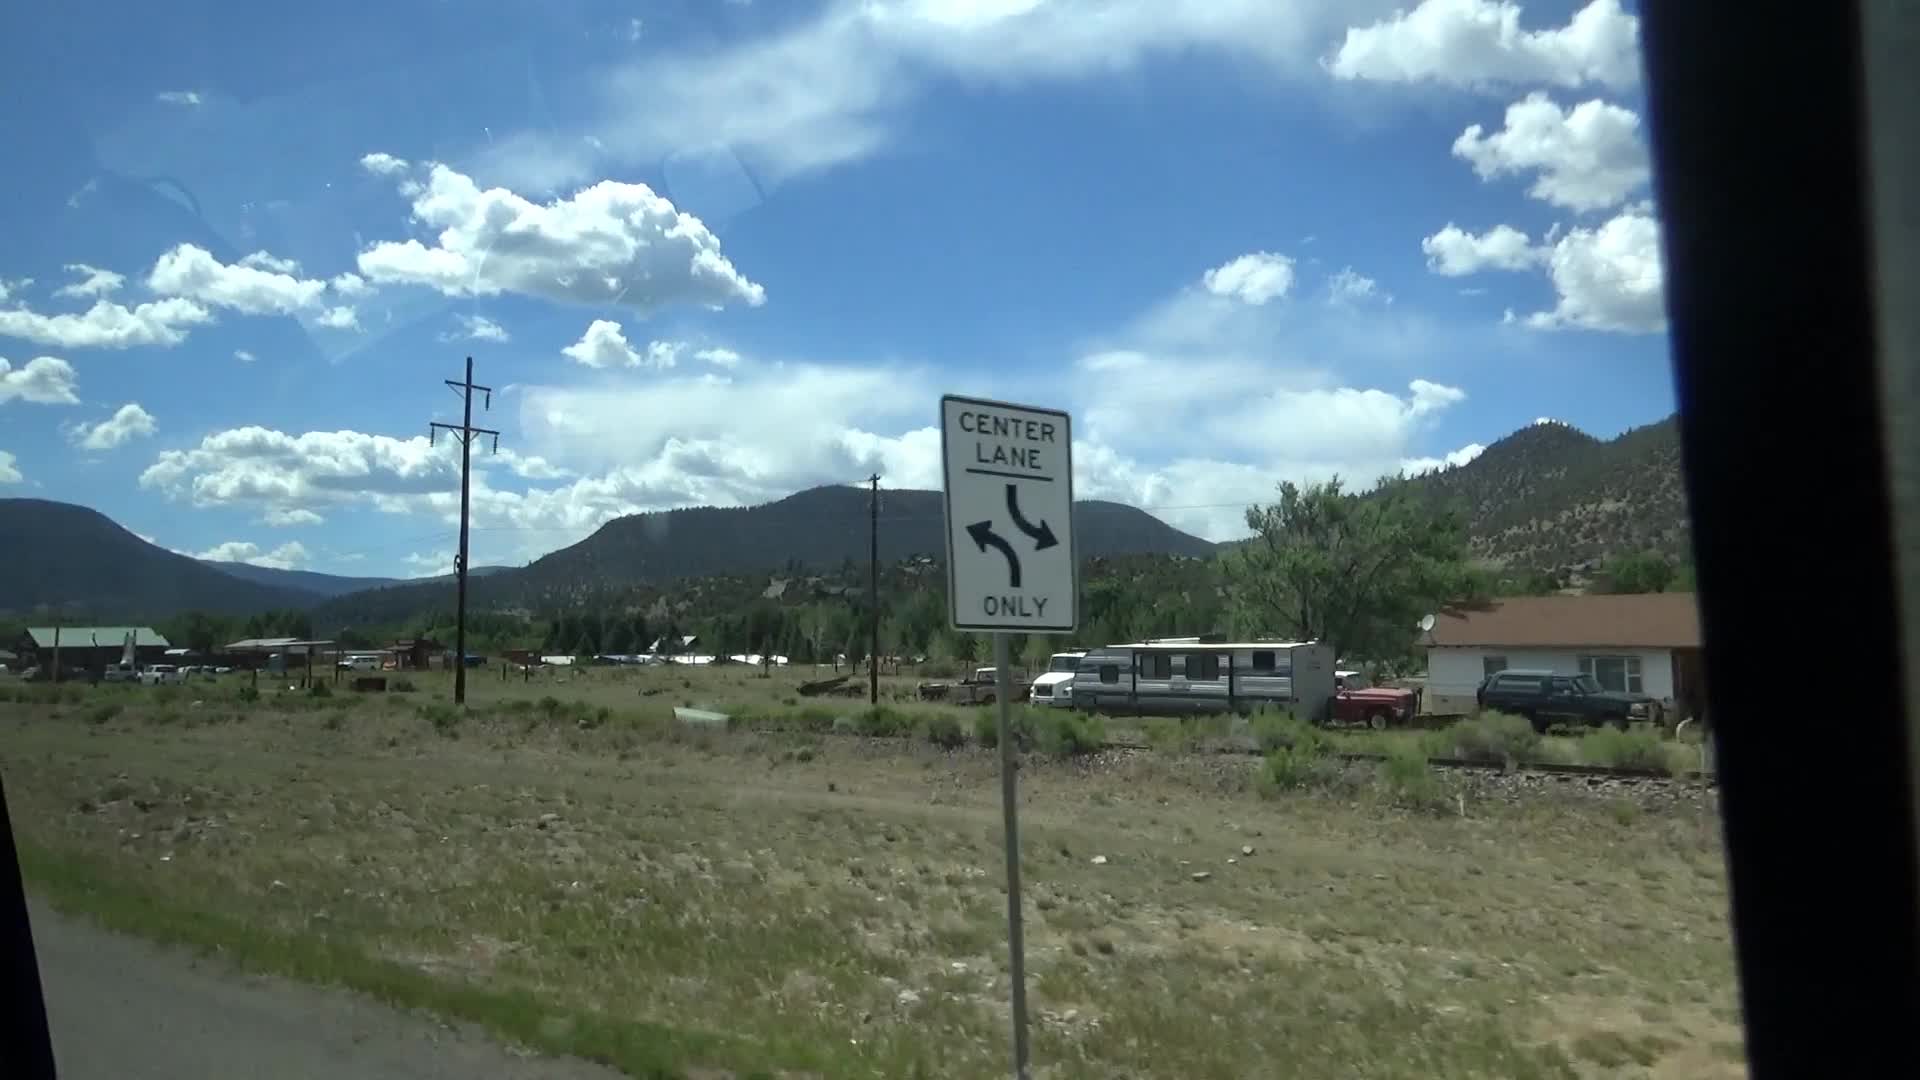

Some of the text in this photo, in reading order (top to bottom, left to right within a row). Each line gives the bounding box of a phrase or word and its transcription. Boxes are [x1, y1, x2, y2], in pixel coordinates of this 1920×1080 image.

[959, 411, 1055, 442] CENTER
[976, 442, 1042, 470] LANE
[983, 596, 1048, 617] ONLY
